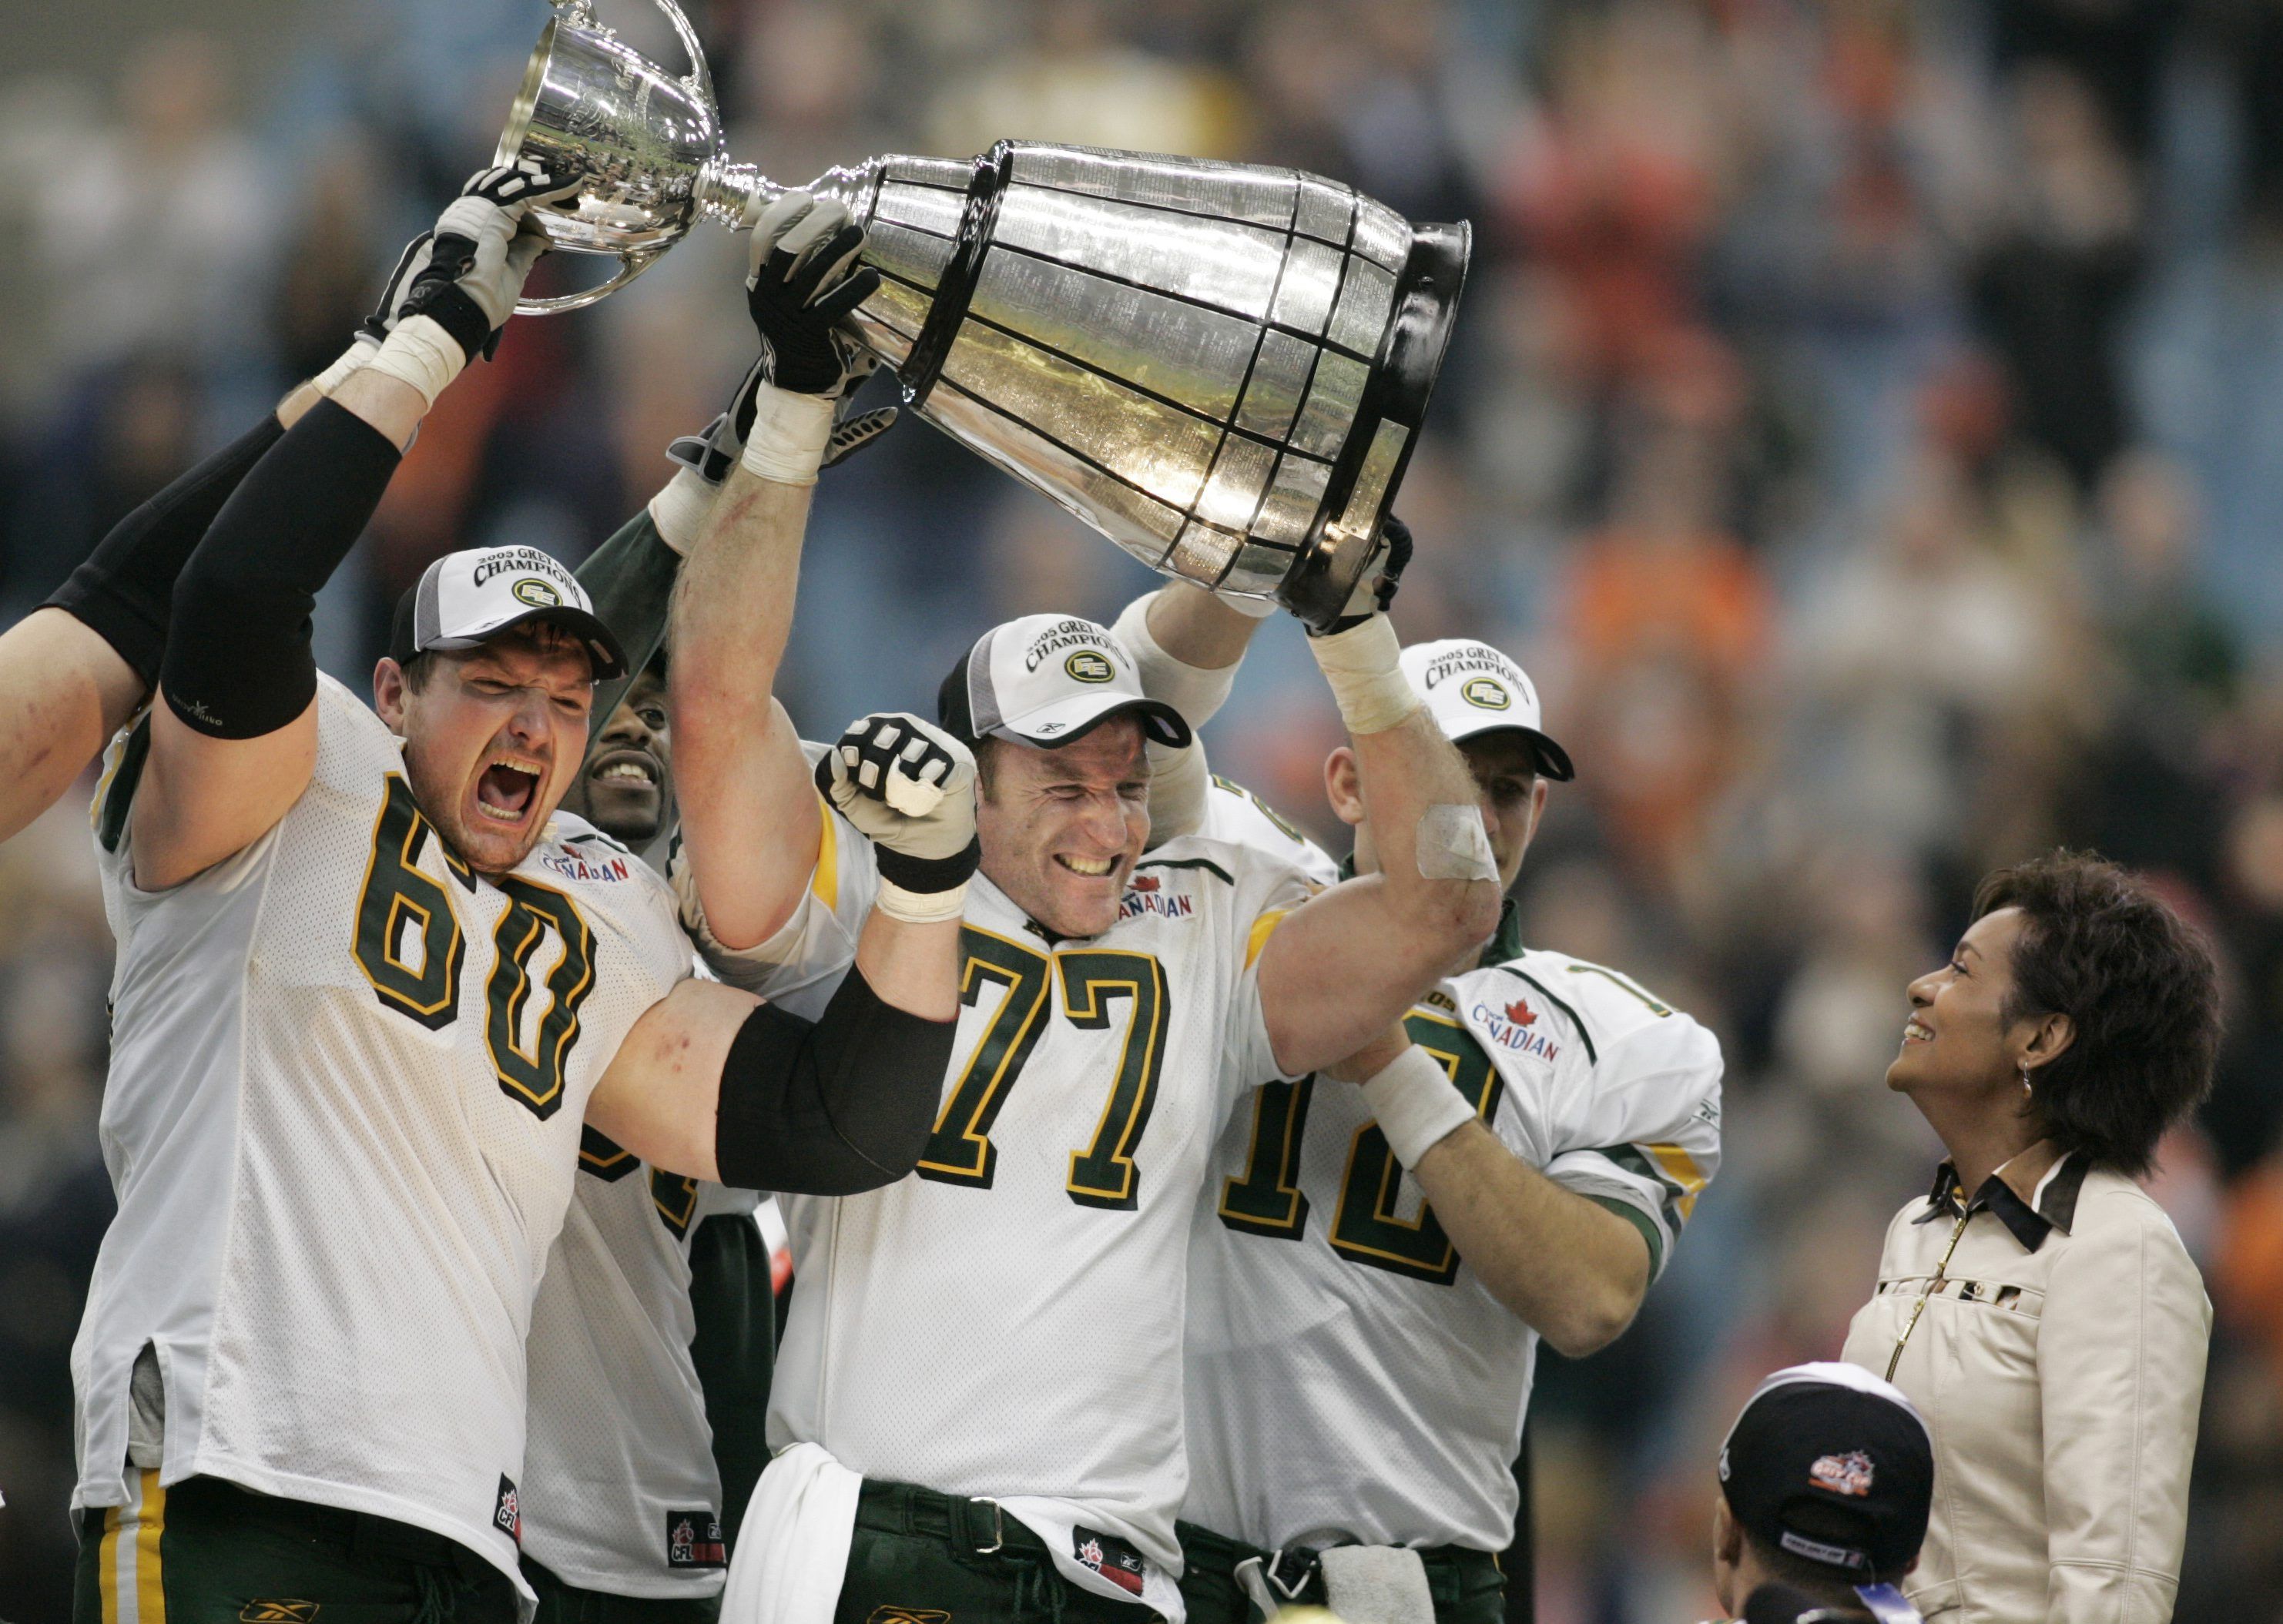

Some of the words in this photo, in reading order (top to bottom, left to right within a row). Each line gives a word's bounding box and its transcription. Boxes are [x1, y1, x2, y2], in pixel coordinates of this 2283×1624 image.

[478, 551, 514, 564] 2005
[518, 548, 552, 566] GREY
[474, 560, 582, 610] CHAMPIONS
[1058, 620, 1093, 635] GREY
[1428, 649, 1463, 665] 2005
[1467, 647, 1500, 663] GREY
[1118, 894, 1192, 920] ANADIAN
[350, 771, 598, 1121] 60
[914, 923, 1171, 1210] 77
[1218, 1009, 1505, 1285] 12
[499, 1508, 515, 1530] CFL
[672, 1544, 693, 1561] CFL
